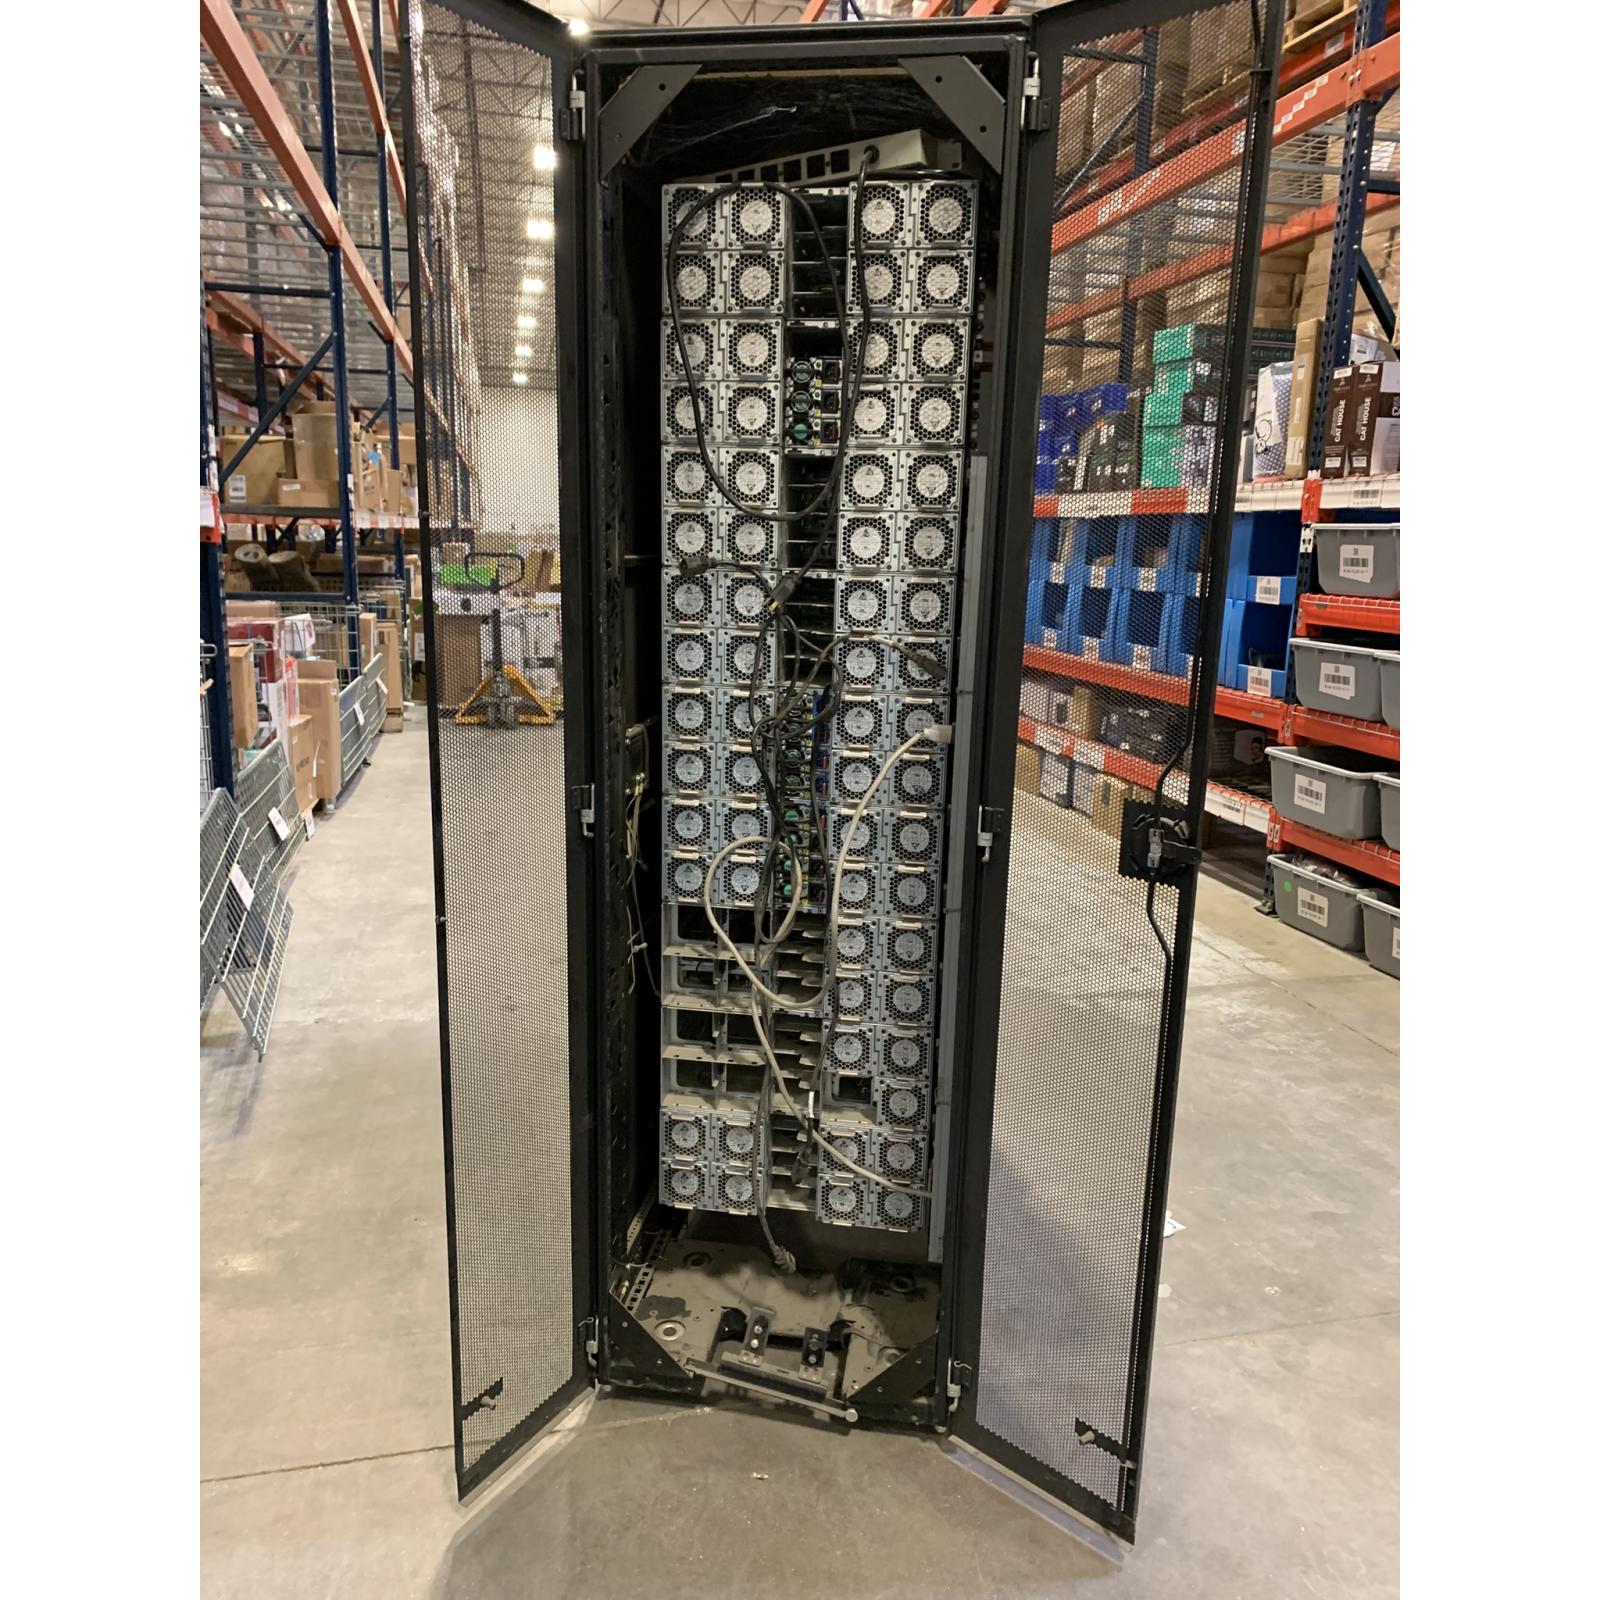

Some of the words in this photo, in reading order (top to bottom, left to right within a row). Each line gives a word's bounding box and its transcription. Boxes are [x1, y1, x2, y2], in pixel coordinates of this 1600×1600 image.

[1337, 400, 1345, 426] HOUSE
[1362, 397, 1371, 424] HOUSE
[1334, 427, 1342, 442] CAT
